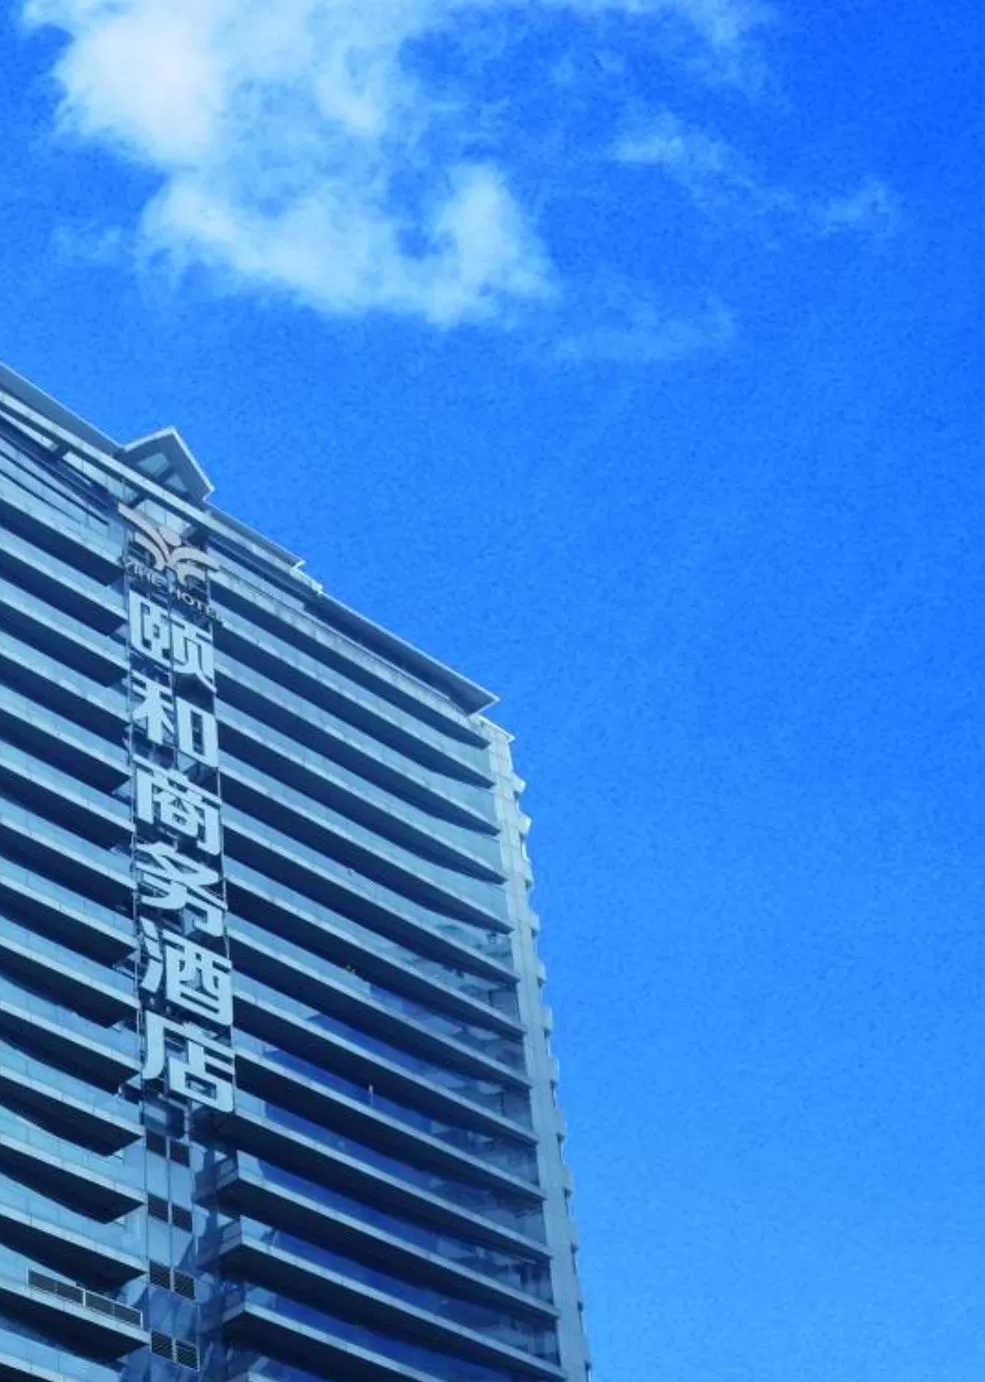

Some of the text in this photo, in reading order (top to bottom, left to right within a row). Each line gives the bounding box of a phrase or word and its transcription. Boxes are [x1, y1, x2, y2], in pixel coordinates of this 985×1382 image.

[128, 590, 233, 1112] 颐和商务酒店
